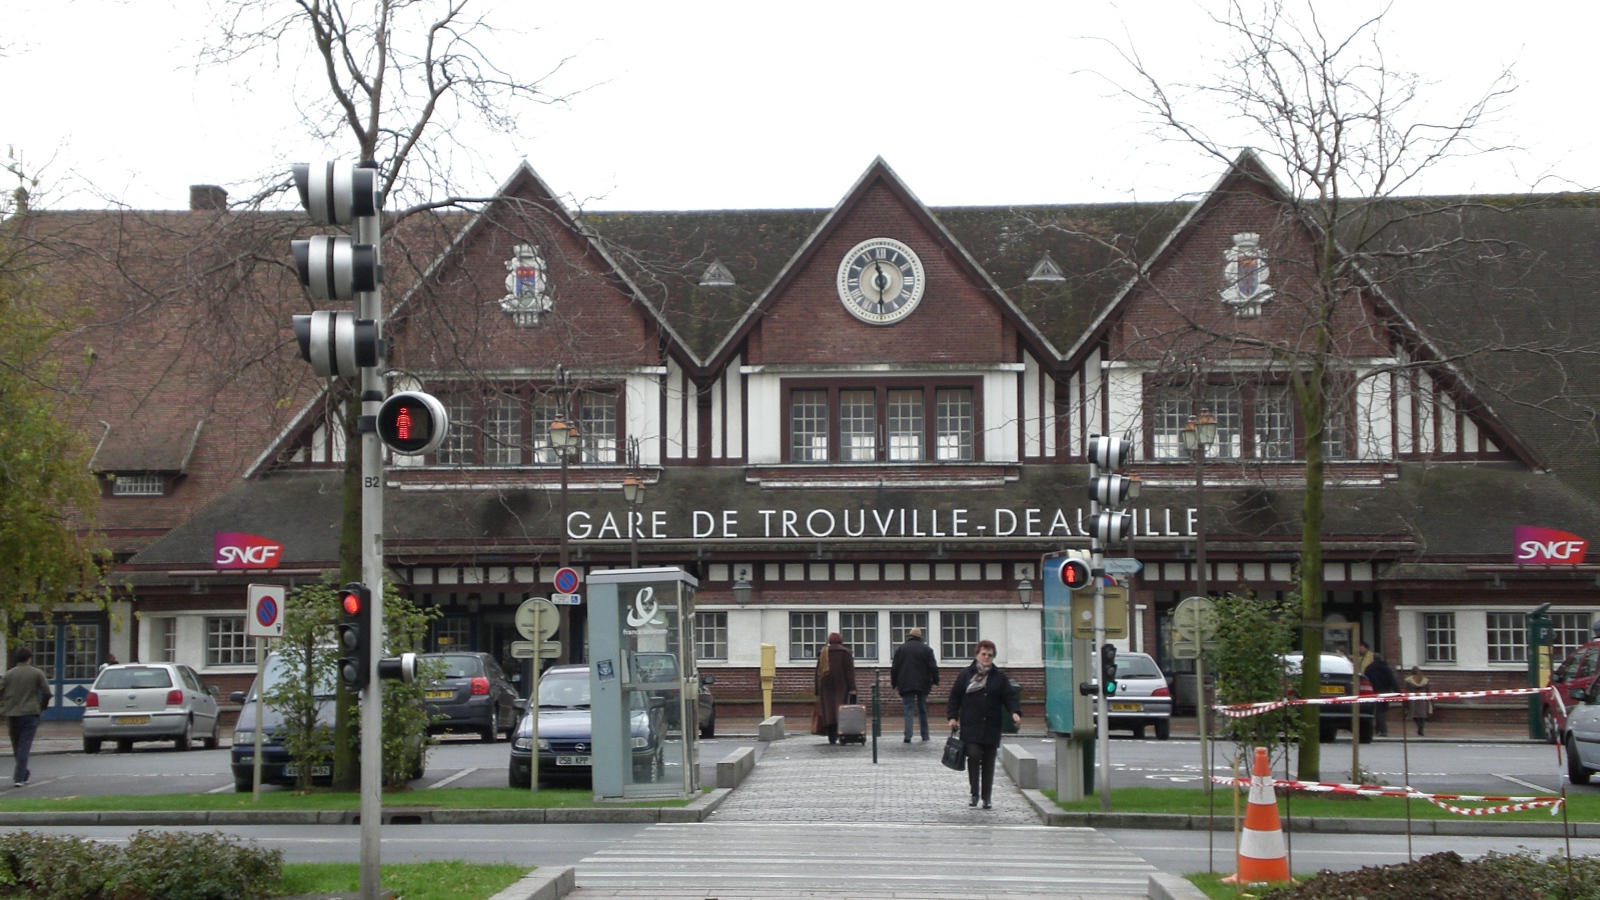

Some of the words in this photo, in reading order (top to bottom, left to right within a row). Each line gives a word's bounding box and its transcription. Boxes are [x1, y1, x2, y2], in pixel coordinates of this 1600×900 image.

[364, 476, 380, 488] B2
[566, 510, 667, 539] GARE
[692, 509, 738, 538] DE
[758, 507, 1198, 538] TROUVILLE-DEAUILLE
[216, 545, 279, 564] SNCF
[1517, 540, 1585, 560] SNCF
[1540, 627, 1548, 639] P
